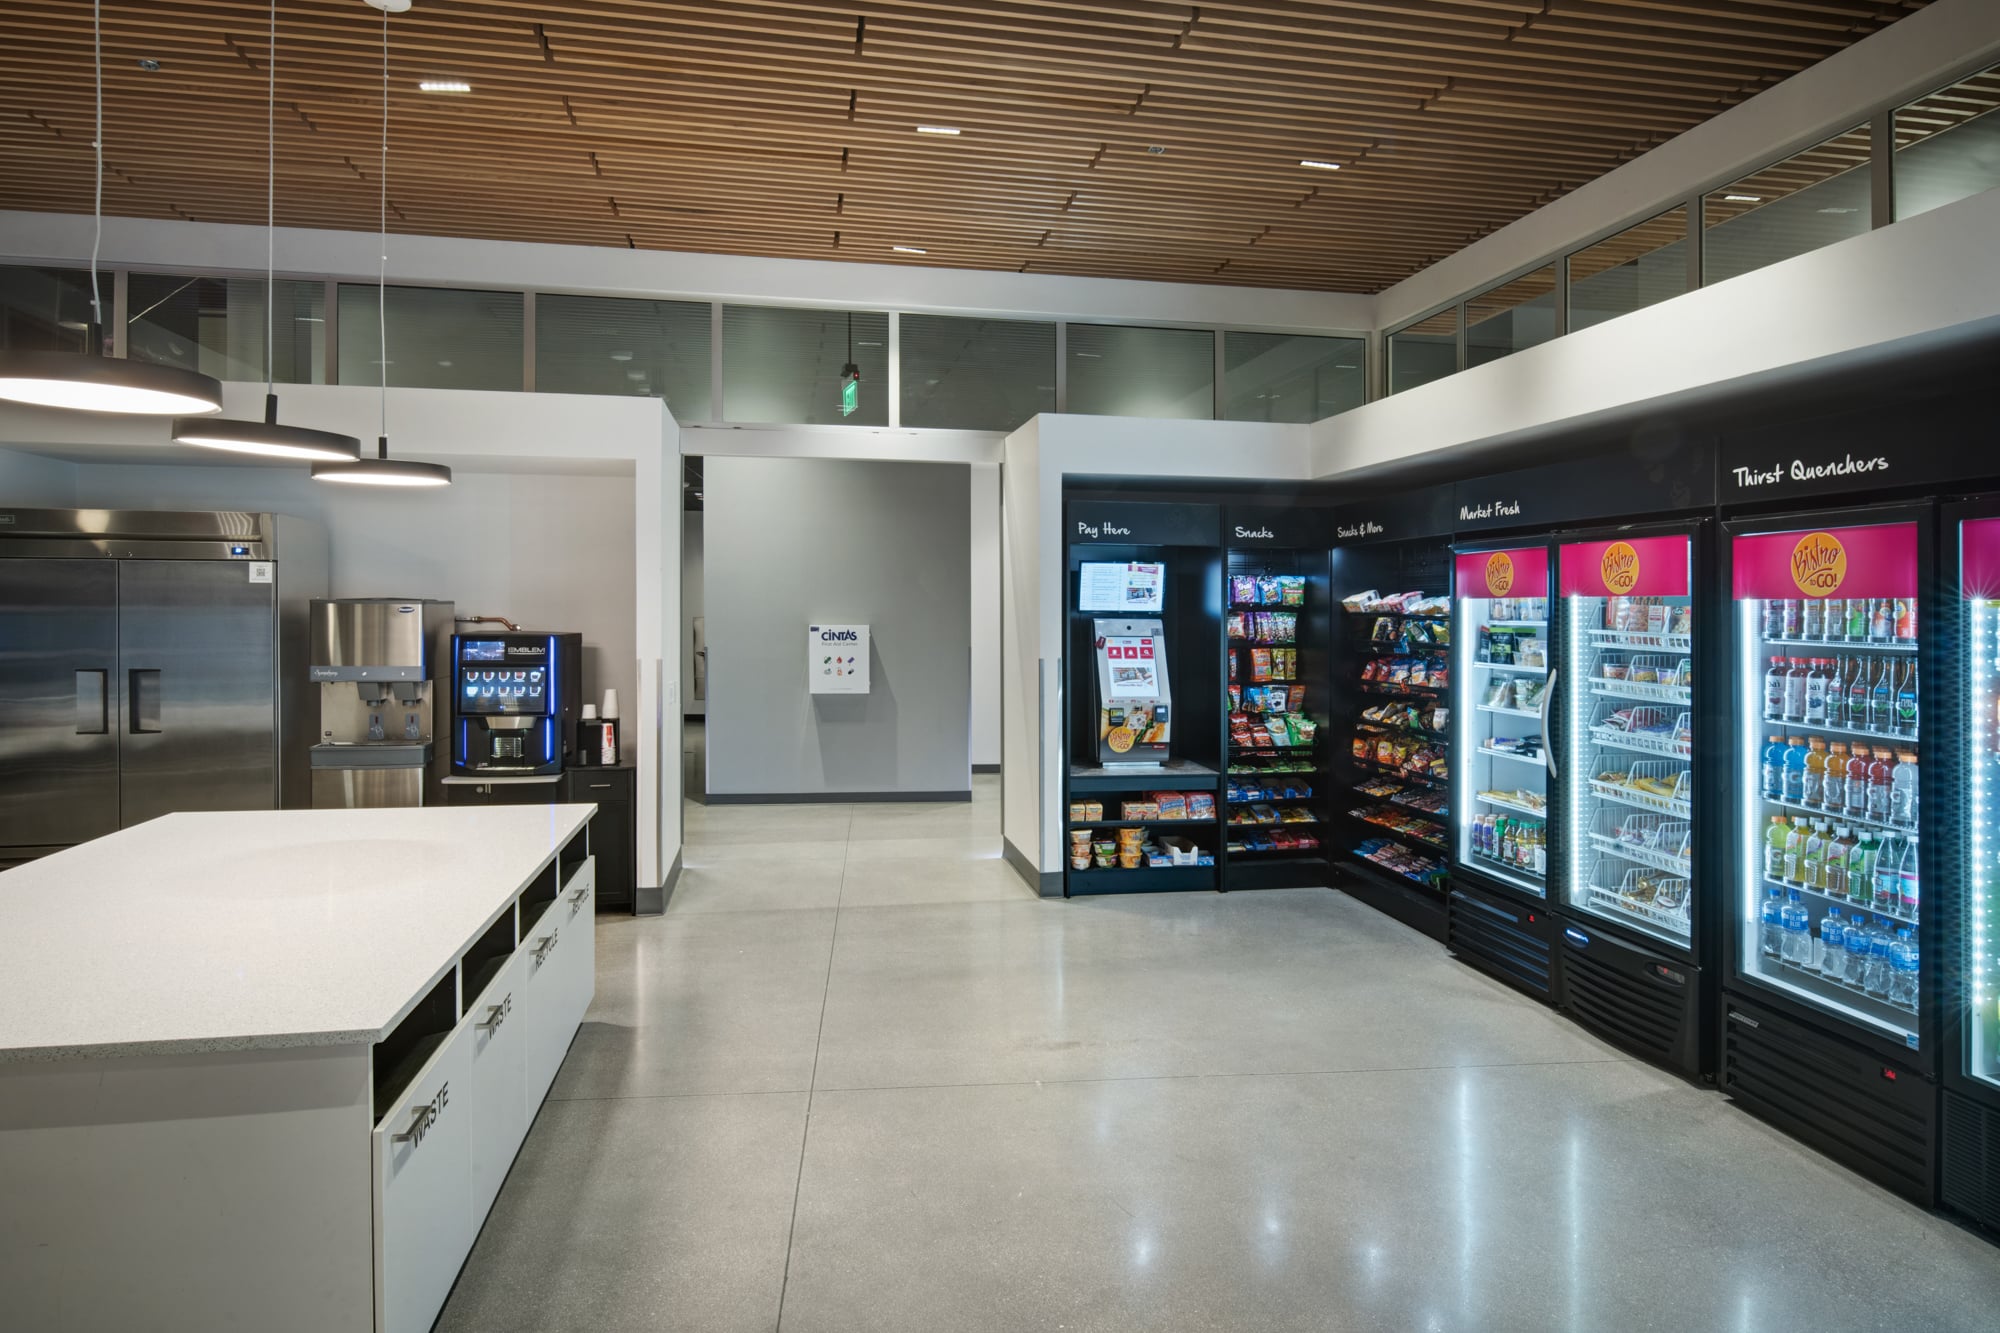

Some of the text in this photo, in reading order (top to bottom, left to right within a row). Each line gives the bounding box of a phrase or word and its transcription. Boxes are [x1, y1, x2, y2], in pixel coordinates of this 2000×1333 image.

[1732, 453, 1889, 487] Thirst Quenchers
[1459, 500, 1520, 521] Market Fresh
[1078, 522, 1131, 538] Pay Here
[1235, 526, 1274, 539] Snacks
[1337, 521, 1384, 538] Snacks & More
[1602, 546, 1634, 582] Bistro
[1793, 536, 1840, 582] Bistro
[1619, 575, 1633, 588] GO!
[1817, 573, 1838, 588] GO!
[573, 883, 589, 913] RELE
[535, 927, 559, 971] RELE
[413, 1080, 449, 1149] WASTE
